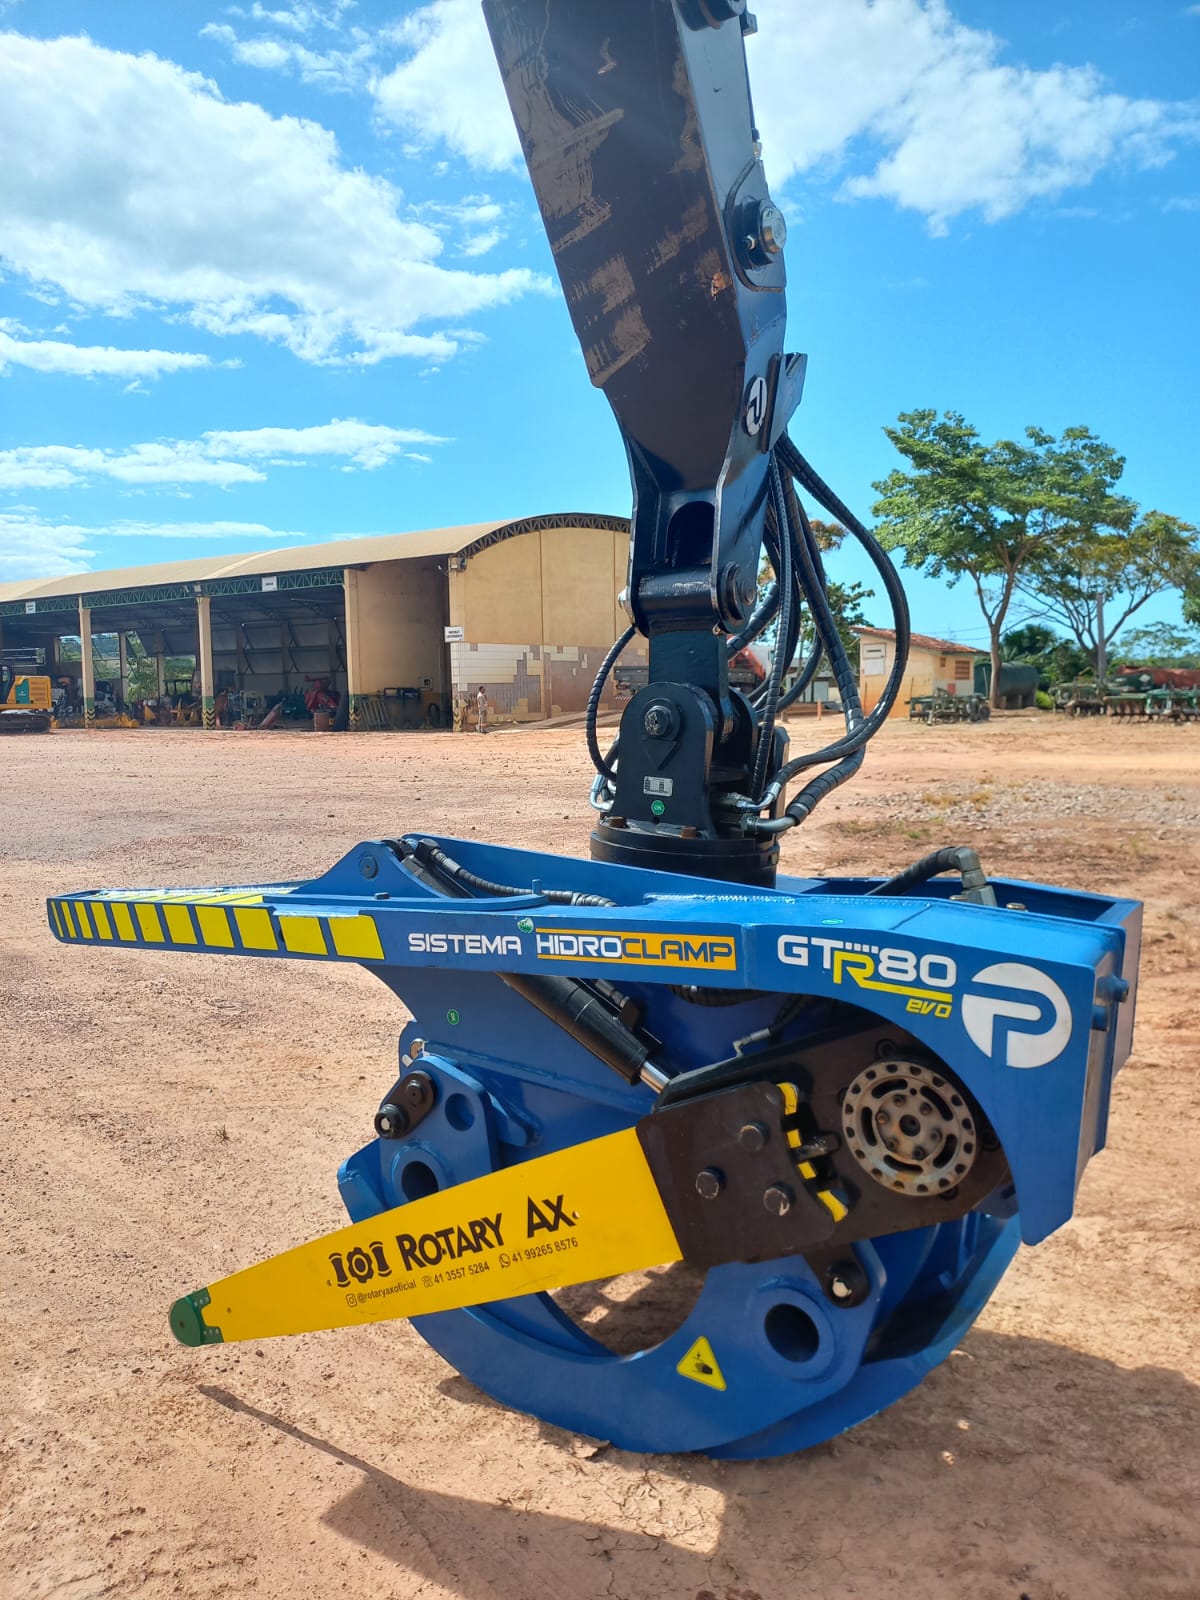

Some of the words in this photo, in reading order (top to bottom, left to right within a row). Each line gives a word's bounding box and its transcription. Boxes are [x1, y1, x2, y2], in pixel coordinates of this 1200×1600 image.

[408, 932, 522, 956] SISTEMA
[535, 932, 734, 964] HIDROCLAMP
[905, 998, 952, 1019] evo
[395, 1212, 505, 1271] ROTARY
[357, 1279, 417, 1304] @rotaryaxoficial
[433, 1273, 445, 1285] 41
[447, 1267, 466, 1281] 3557
[468, 1261, 490, 1276] 5284
[512, 1252, 524, 1264] 41
[526, 1243, 553, 1260] 99265
[556, 1237, 579, 1252] 8576
